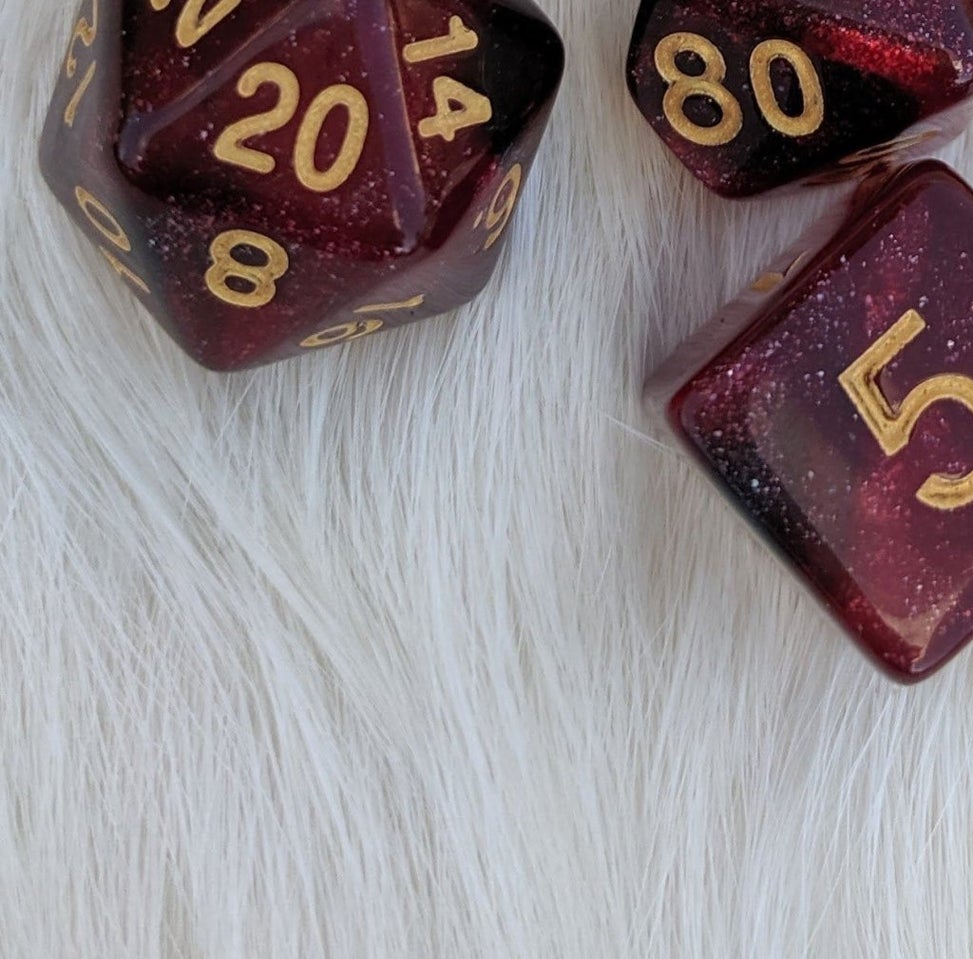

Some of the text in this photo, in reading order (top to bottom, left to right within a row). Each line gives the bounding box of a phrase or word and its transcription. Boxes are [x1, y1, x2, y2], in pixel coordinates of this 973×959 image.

[213, 62, 369, 193] 20
[403, 15, 492, 142] 14
[654, 32, 825, 146] 80
[205, 229, 290, 308] 8
